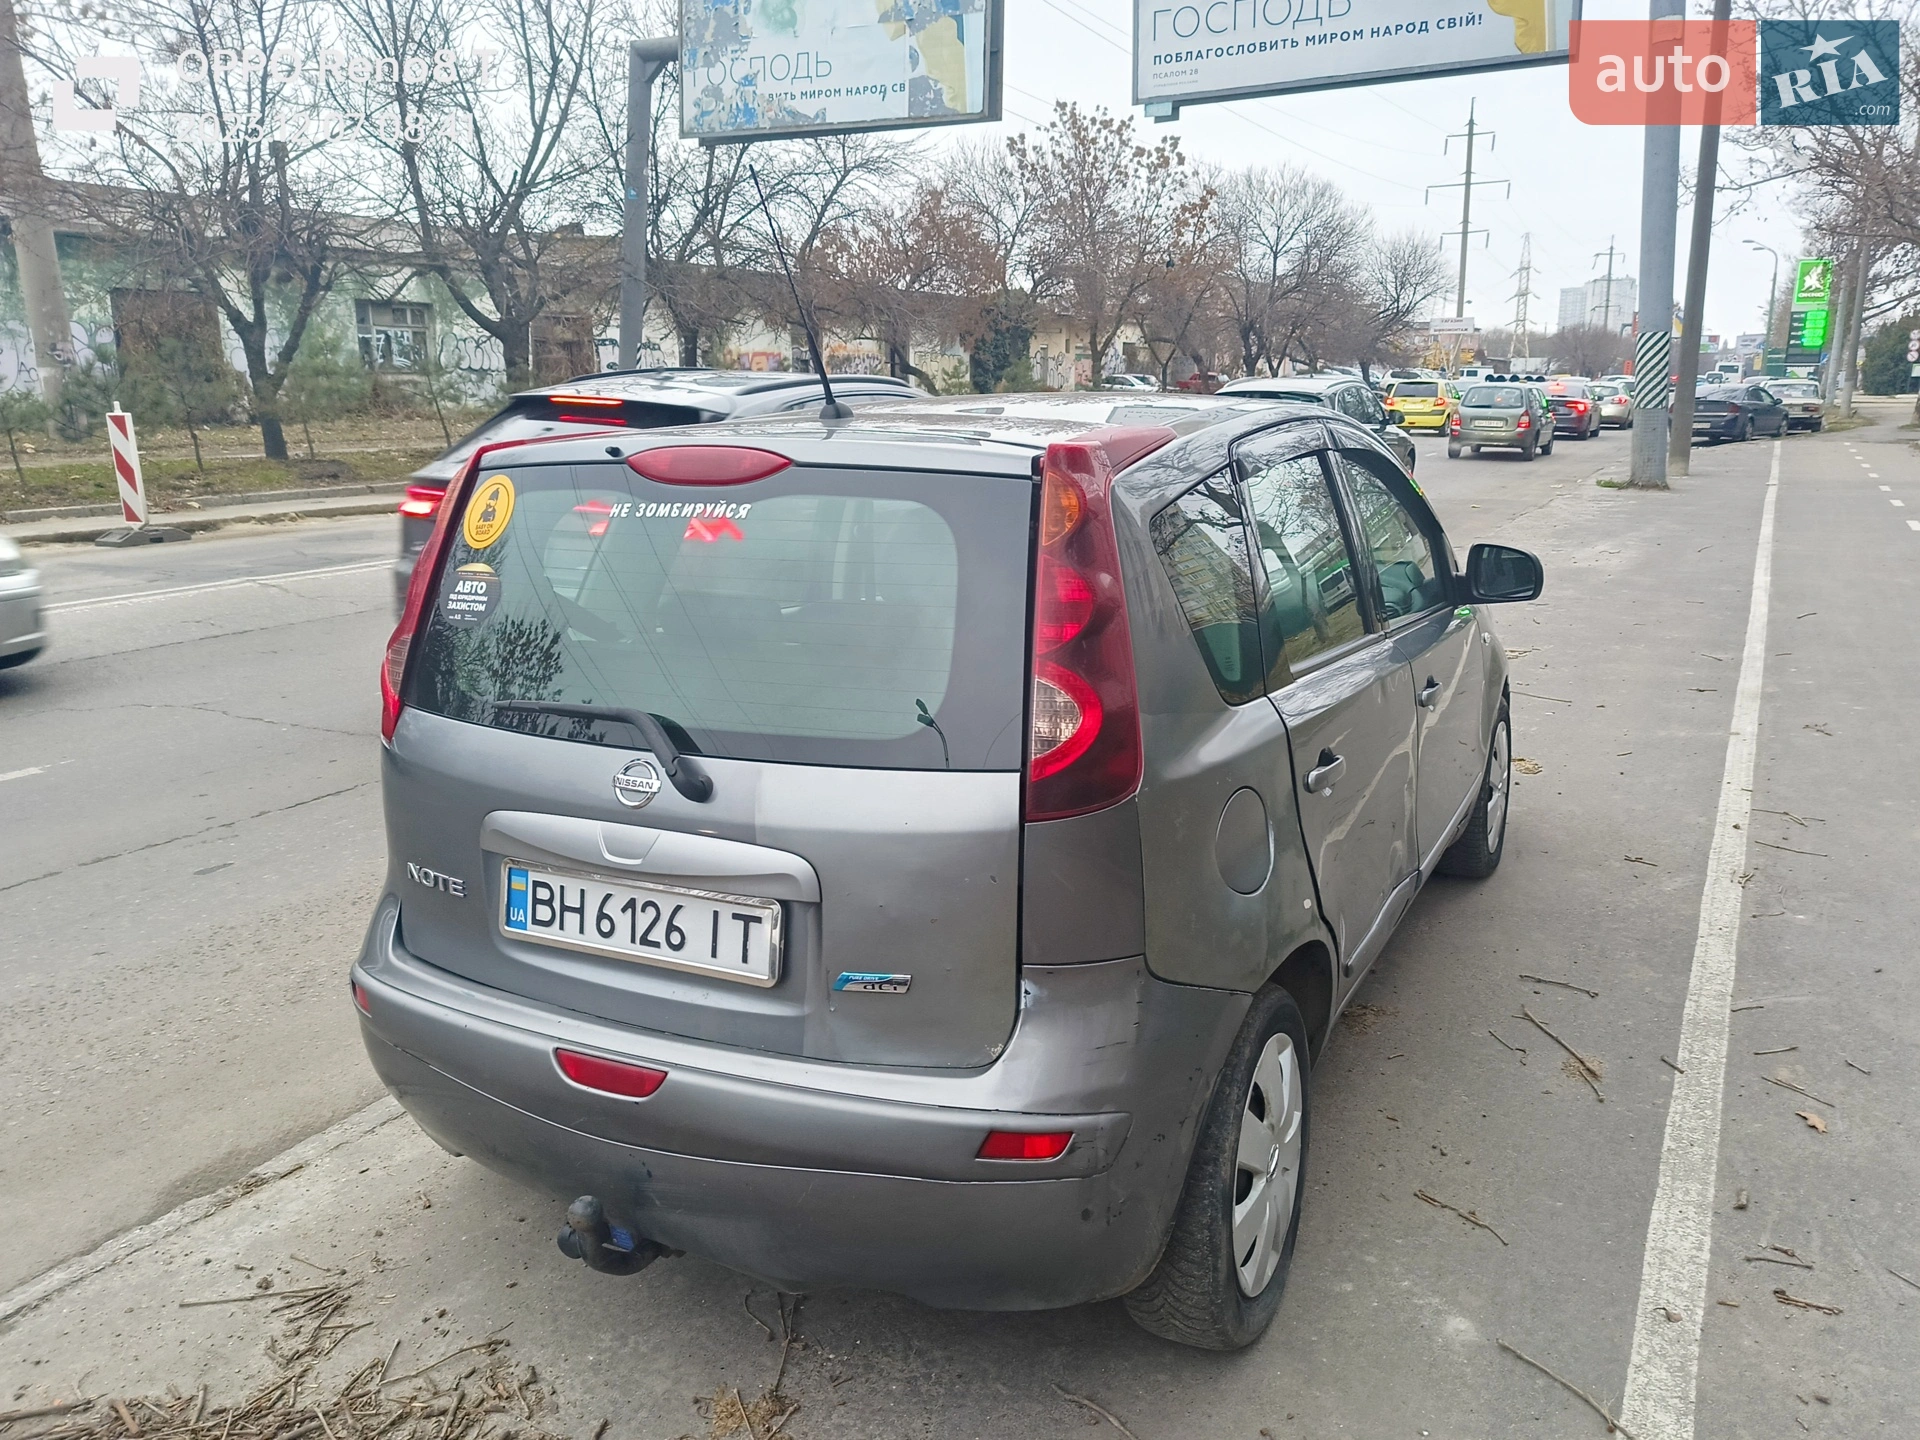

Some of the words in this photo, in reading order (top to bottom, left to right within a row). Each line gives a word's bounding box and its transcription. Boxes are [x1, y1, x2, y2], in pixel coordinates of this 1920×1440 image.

[1153, 0, 1352, 42] ГОСПОДЬ
[1305, 28, 1364, 47] МИРОМ
[1436, 11, 1484, 31] СВІЙ!
[1152, 69, 1187, 80] ПСАЛОМ
[1189, 68, 1199, 76] 28
[800, 87, 842, 100] МИРОМ
[608, 502, 633, 518] НЕ
[635, 499, 753, 520] ЗОМБИРУЙСЯ
[454, 580, 487, 595] АВТО
[446, 600, 487, 612] ЗАХИСТОМ
[615, 776, 655, 790] NISSAN
[406, 861, 468, 899] NOTE
[510, 907, 526, 923] UA
[530, 879, 586, 935] BH
[595, 892, 687, 952] 6126
[710, 909, 763, 965] IT
[863, 983, 898, 992] dCi
